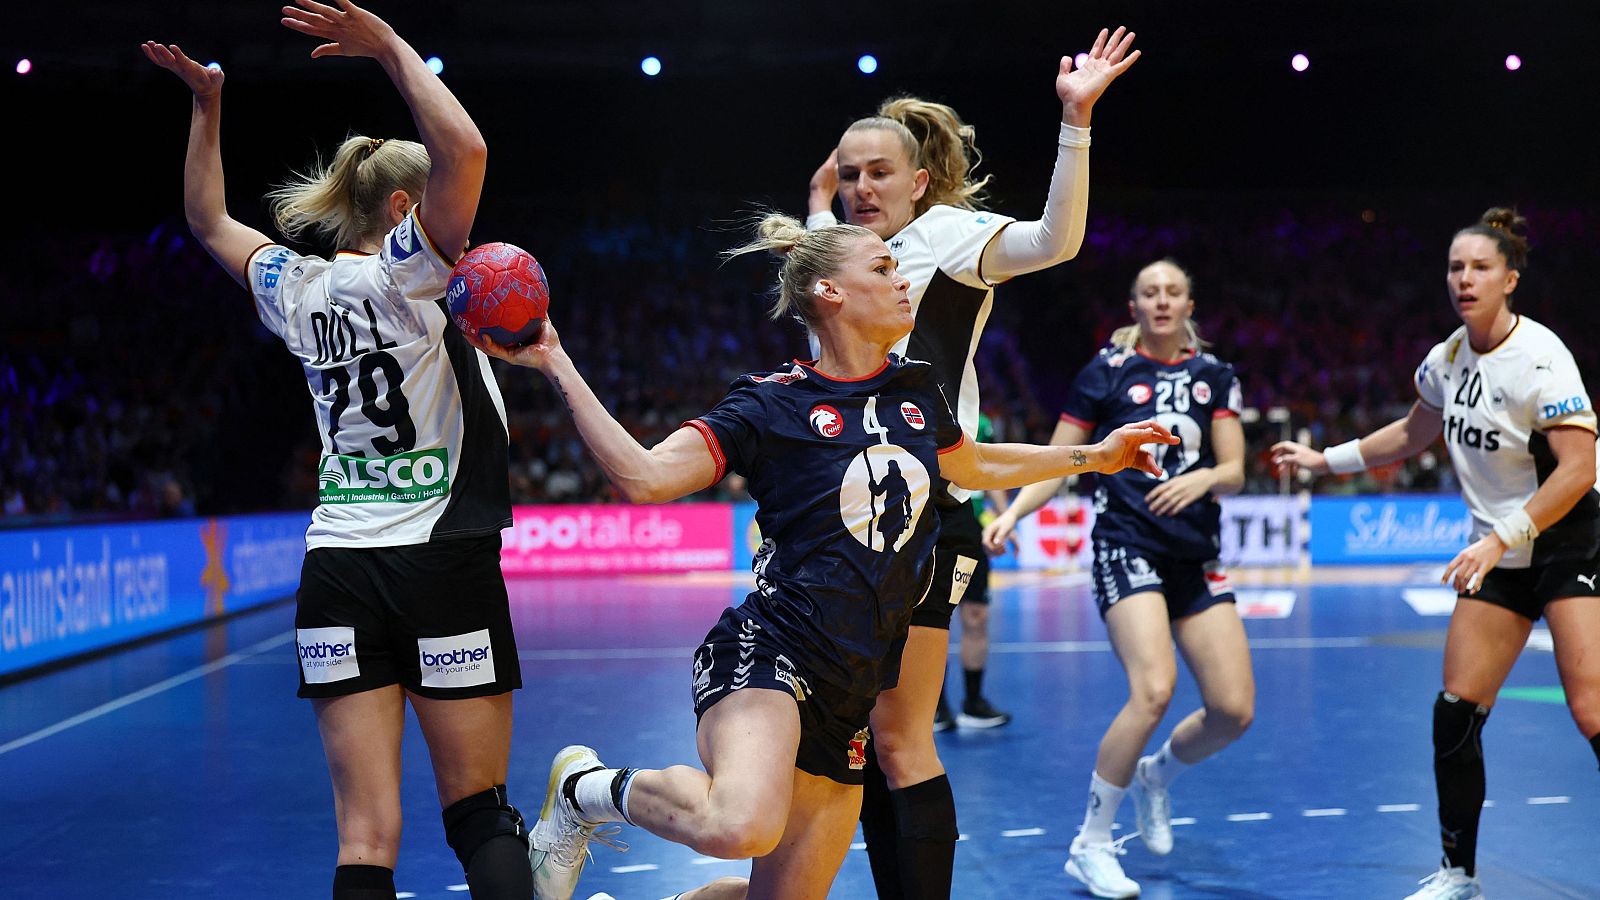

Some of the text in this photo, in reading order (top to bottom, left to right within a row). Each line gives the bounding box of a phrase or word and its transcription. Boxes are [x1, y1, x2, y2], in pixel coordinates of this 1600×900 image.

[311, 298, 397, 365] DÖLL
[1155, 376, 1191, 414] 25
[1454, 367, 1483, 409] 20
[321, 350, 416, 456] 29
[1544, 396, 1585, 419] DKB
[827, 423, 841, 435] NHF
[863, 397, 889, 445] 4
[1443, 416, 1500, 452] tlas
[351, 493, 385, 501] Industrie
[391, 492, 416, 500] Gastro
[423, 488, 444, 497] Hotel
[299, 642, 353, 659] brother
[422, 646, 489, 667] brother
[326, 659, 342, 667] side
[436, 663, 481, 675] at your side
